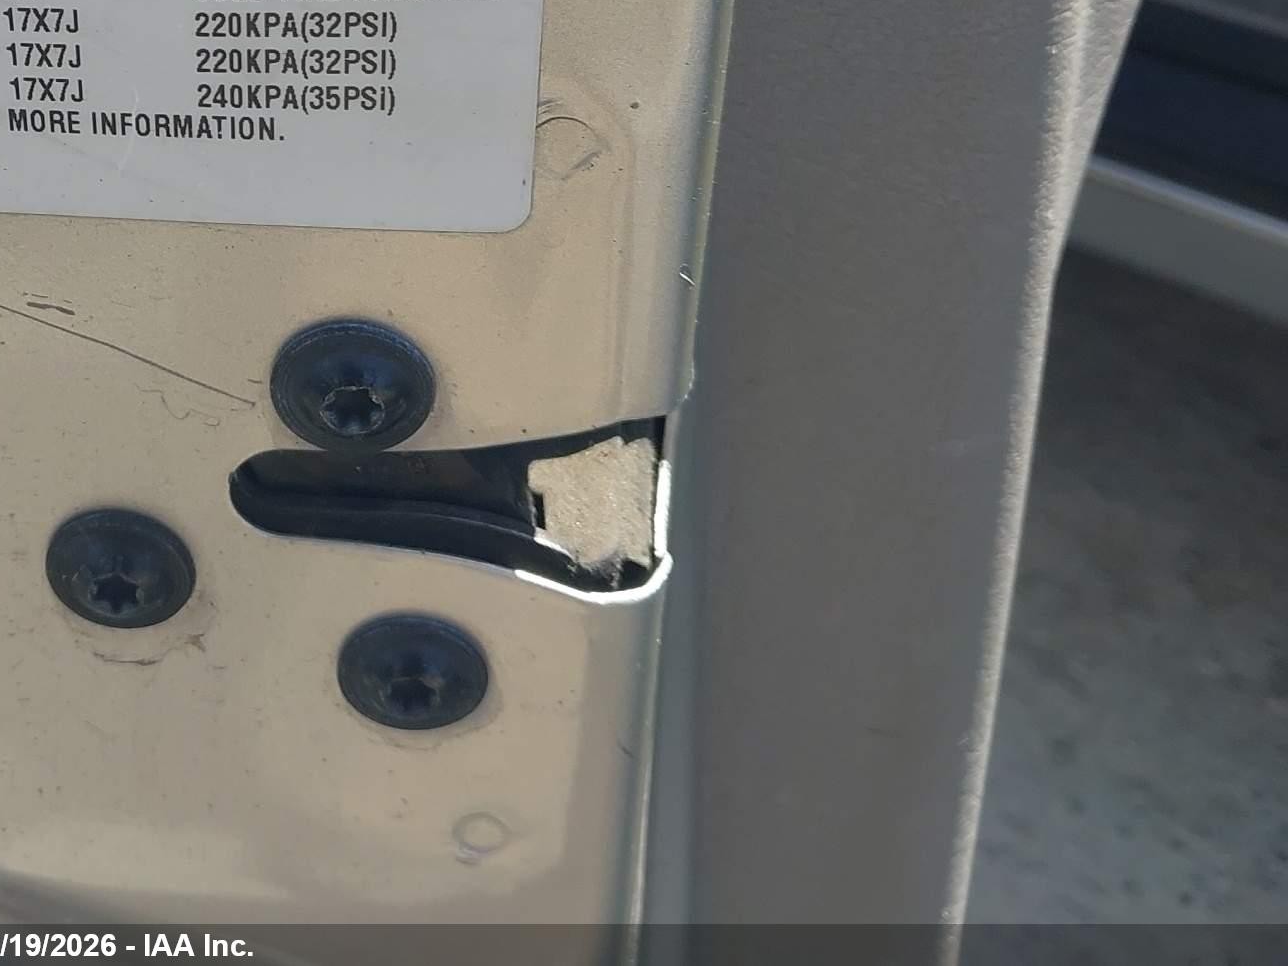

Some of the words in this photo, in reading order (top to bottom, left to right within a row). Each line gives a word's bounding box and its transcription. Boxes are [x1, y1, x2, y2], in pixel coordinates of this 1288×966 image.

[3, 7, 79, 33] 17X7J
[195, 11, 397, 43] 220KPA(32PSI)
[6, 43, 81, 68] 17X7J
[196, 48, 396, 80] 220KPA(32PSI)
[9, 77, 84, 102] 17X7J
[197, 84, 395, 116] 240KPA(35PSI)
[8, 109, 80, 134] MORE
[92, 112, 284, 141] INFORMATION.
